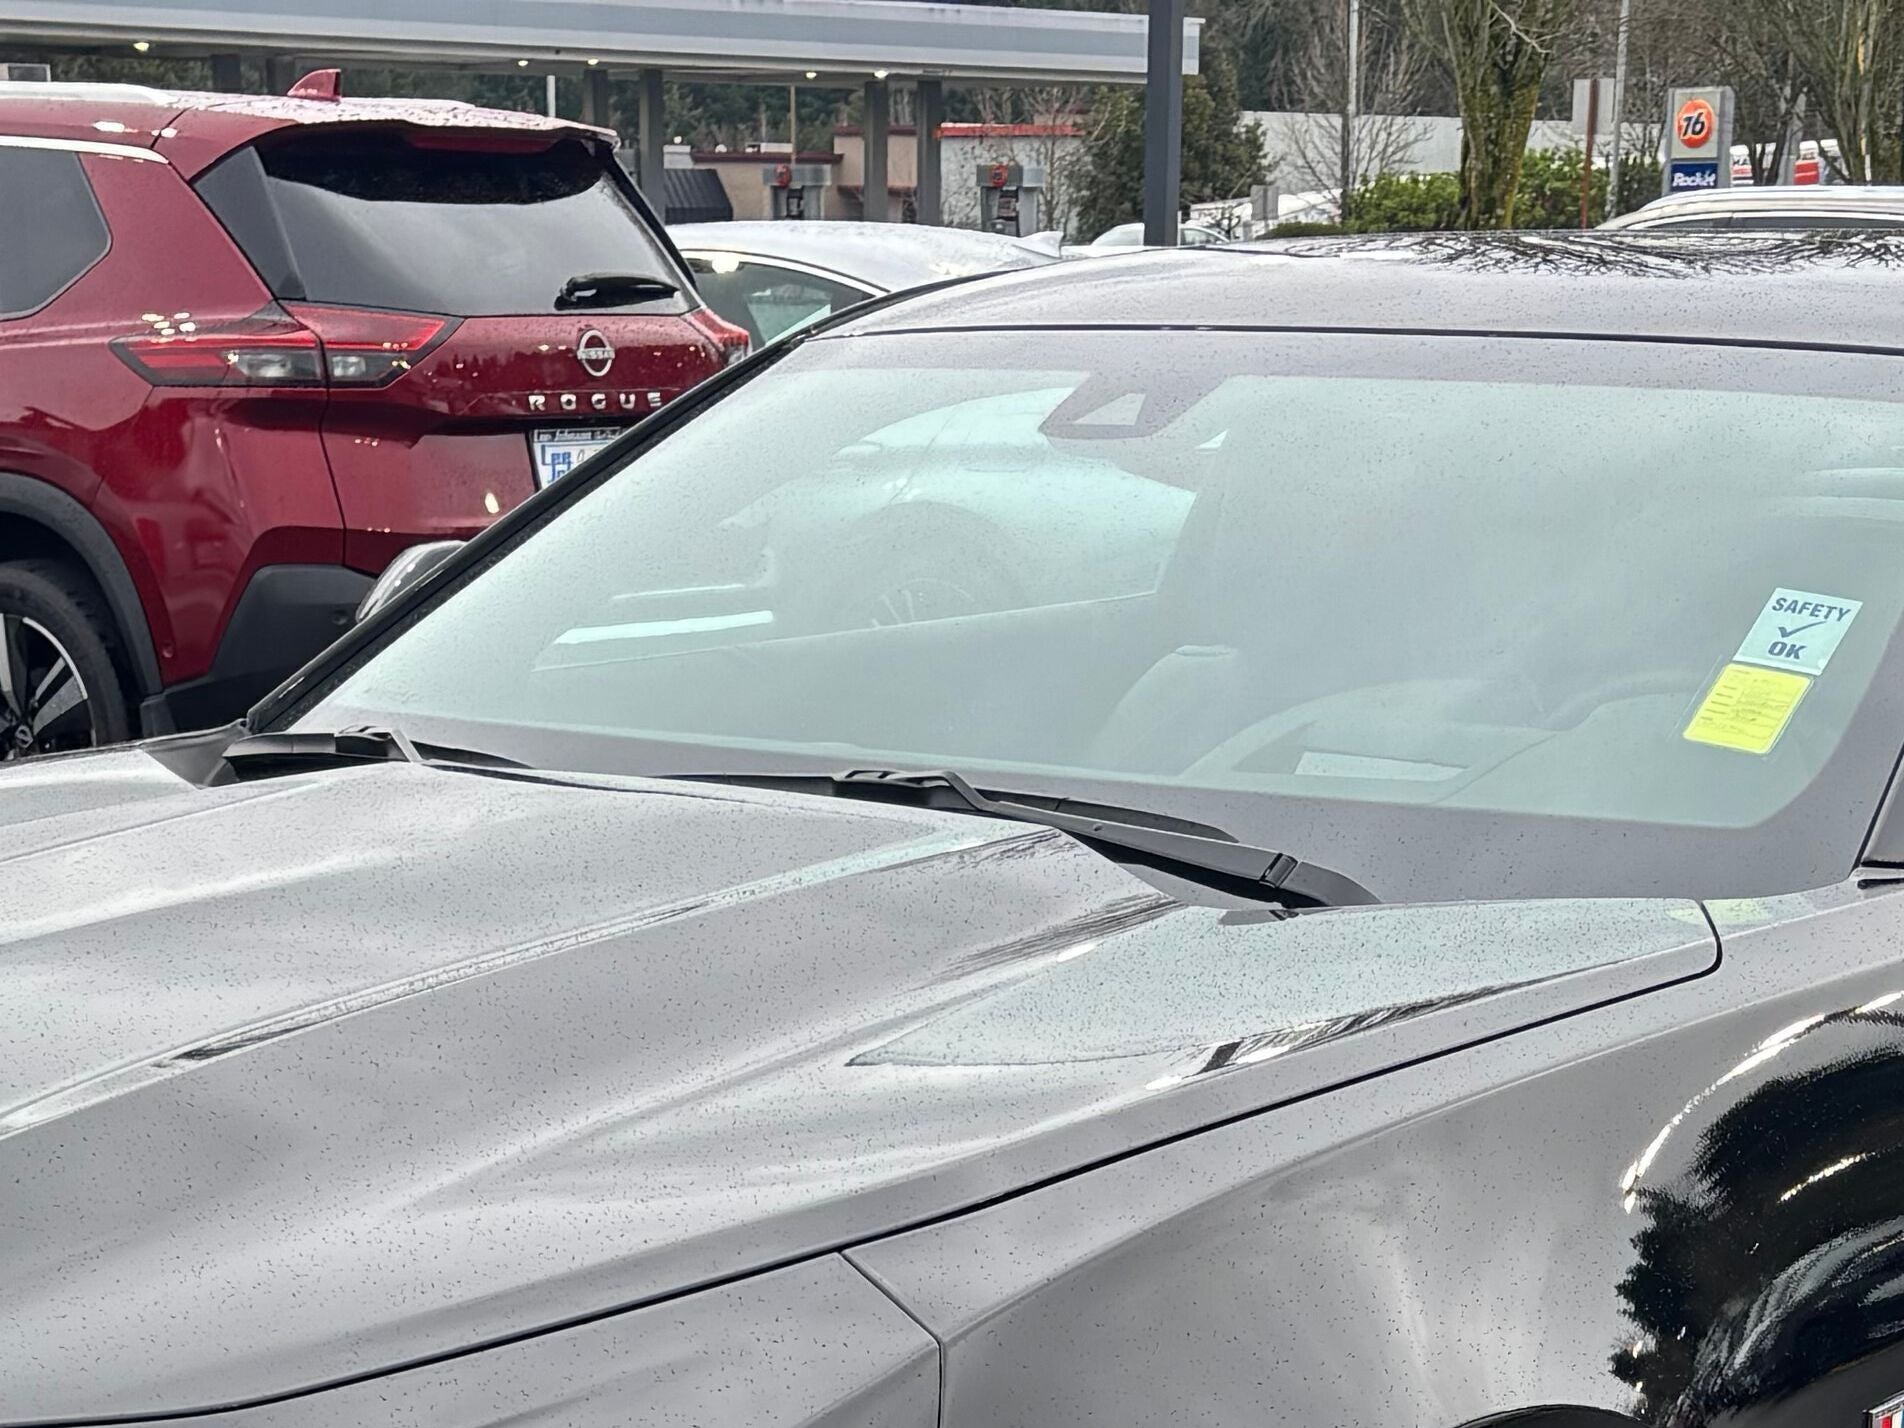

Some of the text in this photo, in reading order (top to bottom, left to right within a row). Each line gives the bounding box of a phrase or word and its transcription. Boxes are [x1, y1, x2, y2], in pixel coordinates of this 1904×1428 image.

[1681, 111, 1707, 137] 76
[528, 392, 662, 411] ROGUE
[541, 445, 573, 466] Lee
[1772, 597, 1851, 622] SAFETY
[1768, 641, 1807, 659] OK
